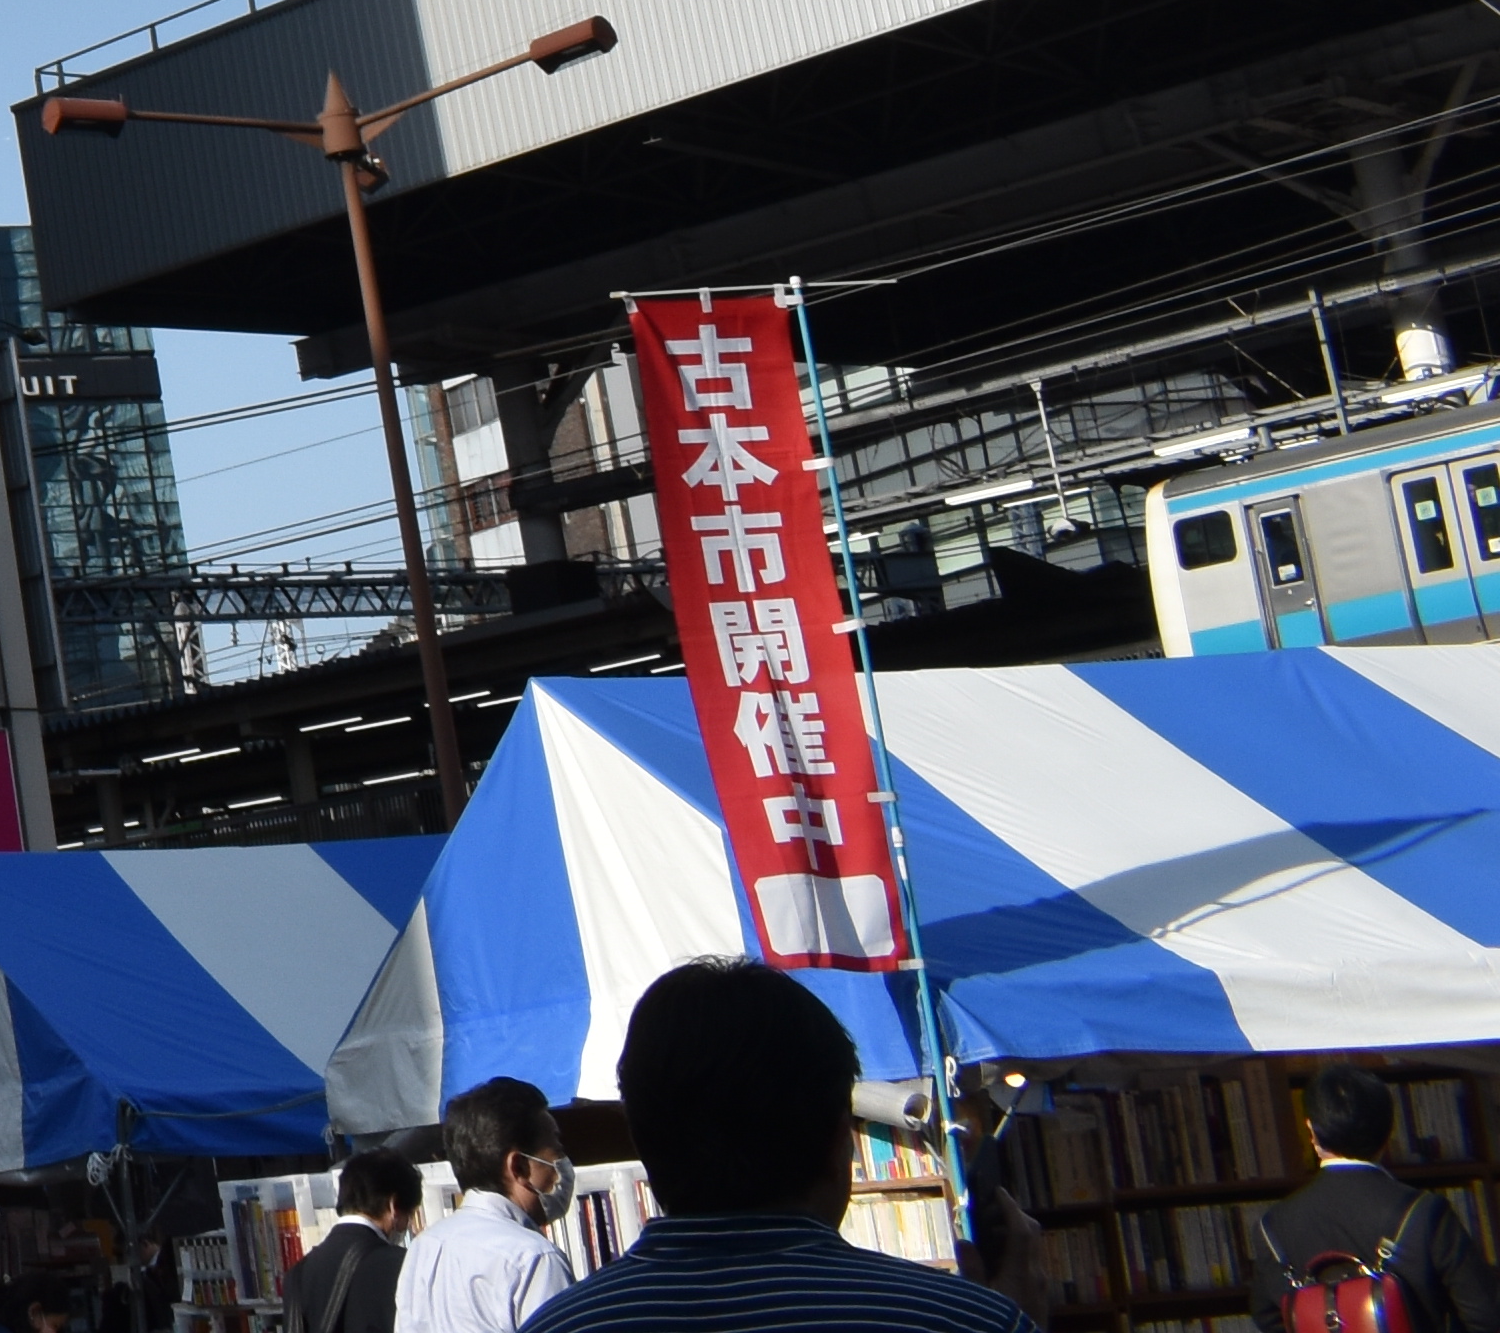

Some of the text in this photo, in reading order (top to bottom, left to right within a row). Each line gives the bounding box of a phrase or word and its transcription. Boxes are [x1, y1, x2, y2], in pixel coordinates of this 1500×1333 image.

[664, 322, 845, 871] 古本市開催中
